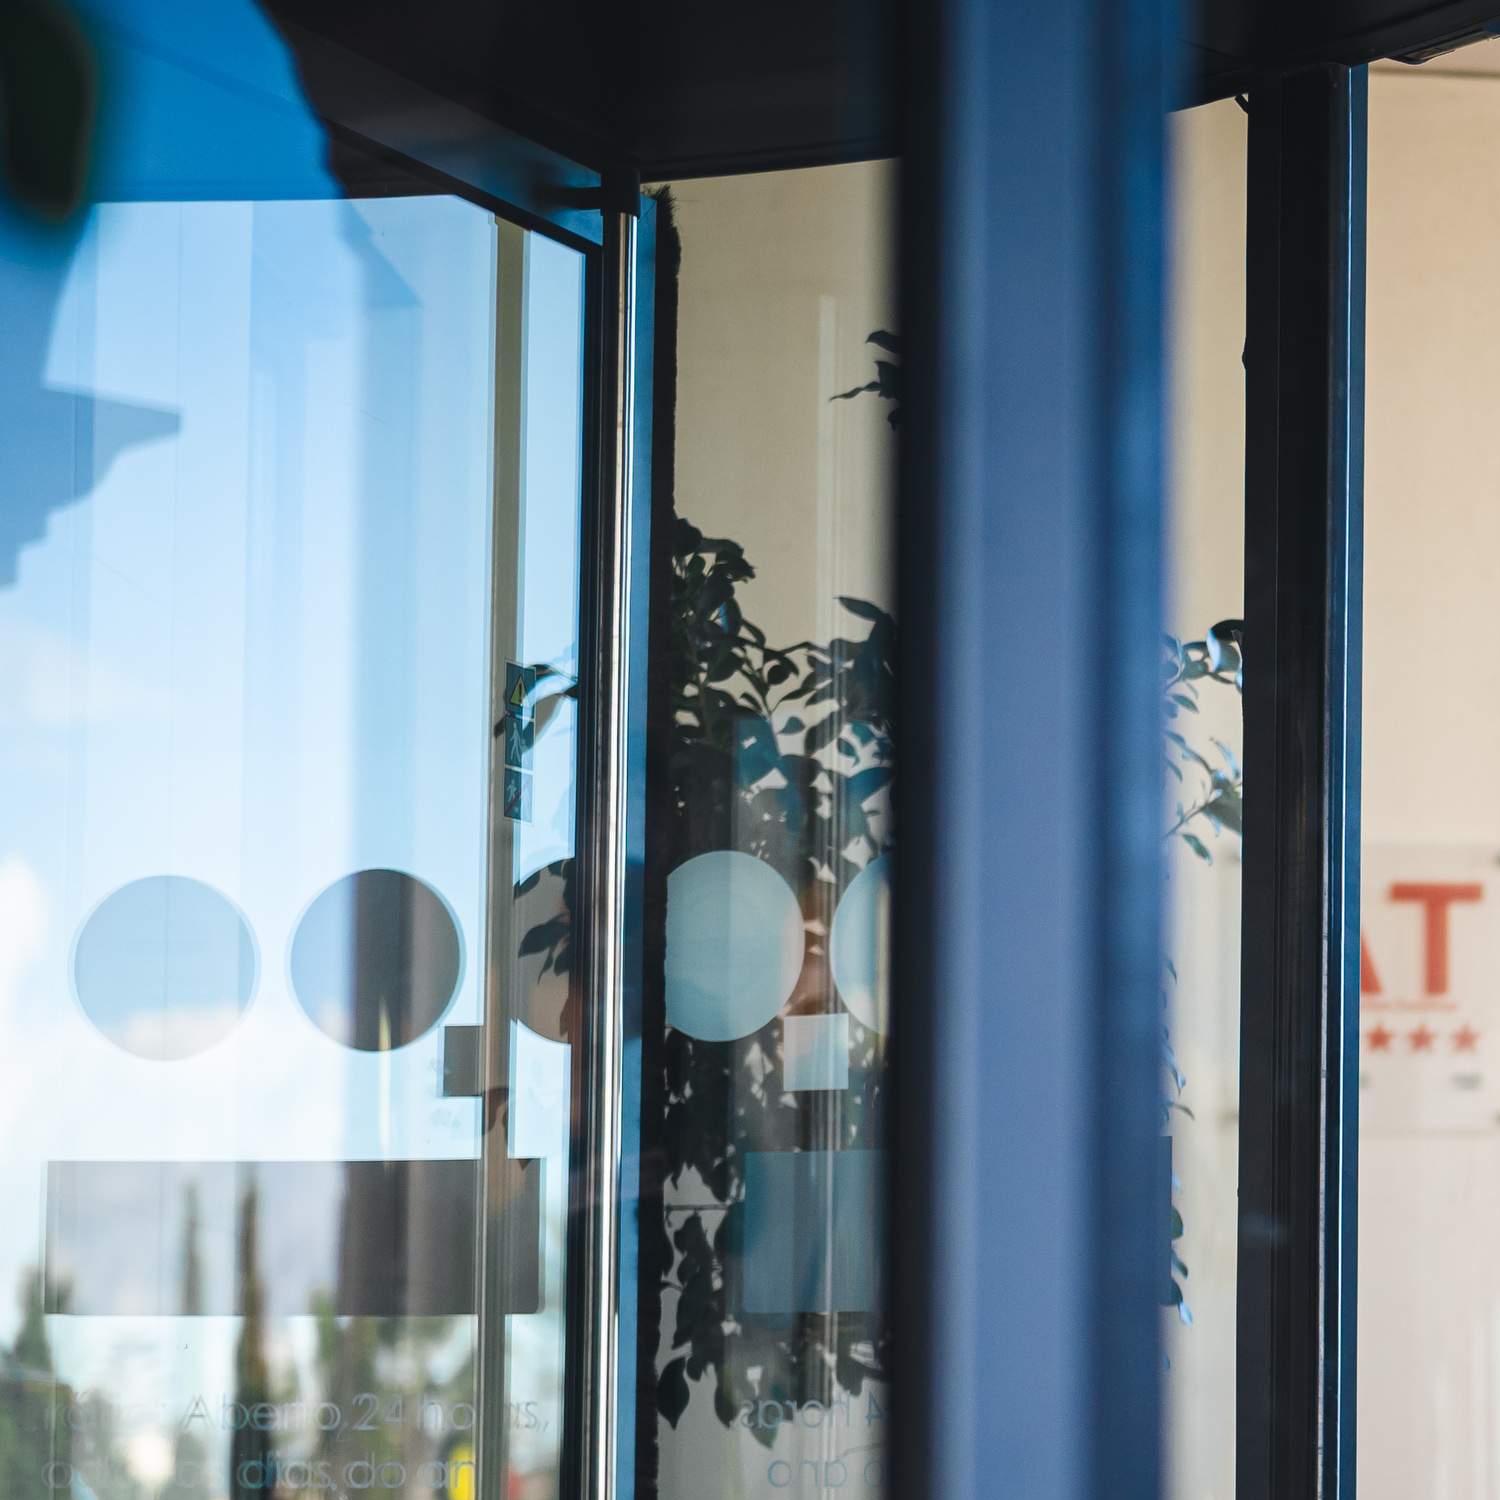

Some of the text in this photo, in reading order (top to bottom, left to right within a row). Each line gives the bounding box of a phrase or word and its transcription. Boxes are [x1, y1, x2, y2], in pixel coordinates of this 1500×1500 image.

[1360, 881, 1484, 996] T
[352, 1393, 406, 1431] 24
[341, 1452, 408, 1490] do
[416, 1460, 477, 1490] an
